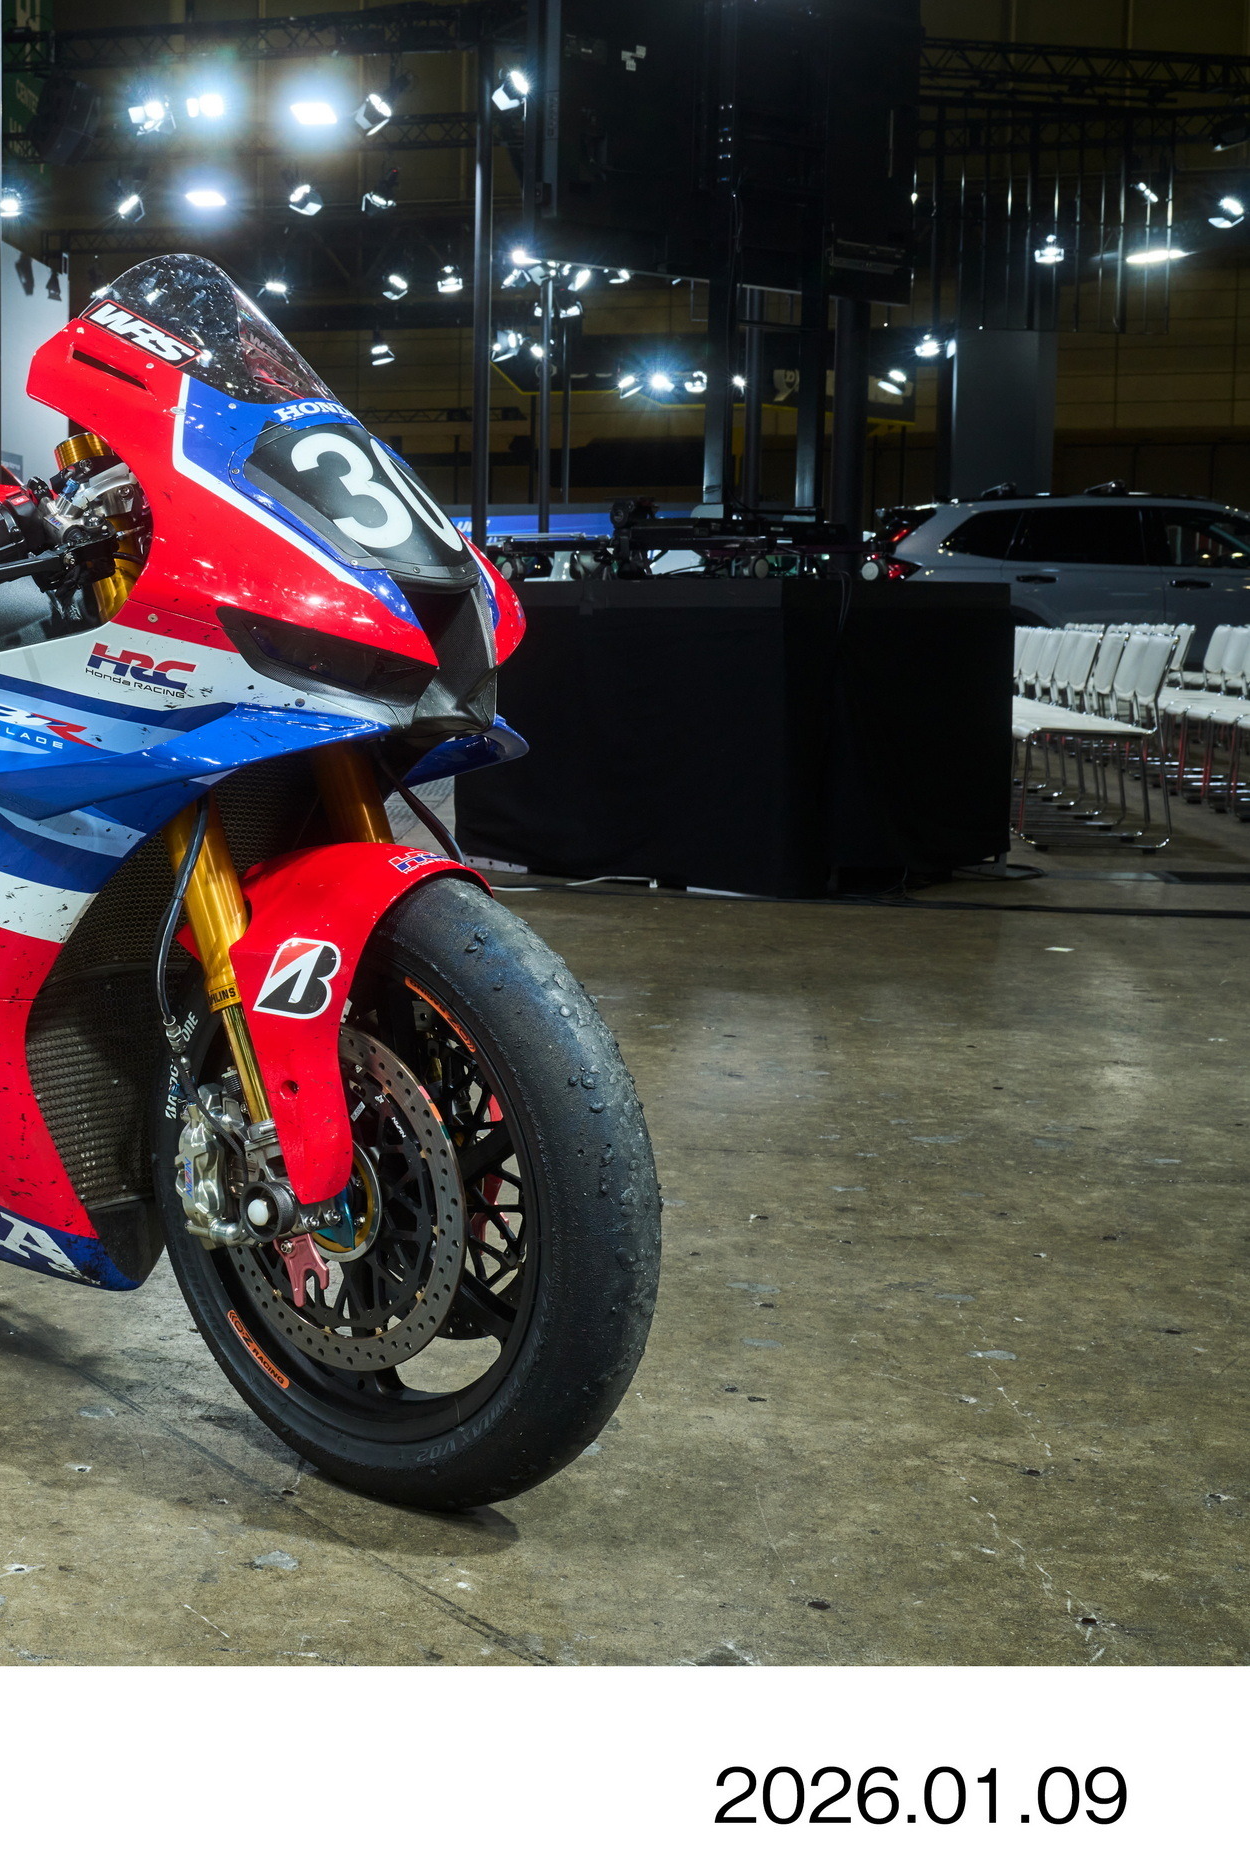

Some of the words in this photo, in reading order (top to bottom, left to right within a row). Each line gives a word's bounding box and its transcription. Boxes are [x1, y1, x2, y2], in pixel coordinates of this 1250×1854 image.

[89, 303, 196, 361] WRS
[274, 402, 356, 421] HOND
[291, 433, 463, 552] 30
[85, 668, 131, 686] Honda
[133, 681, 185, 699] RACING
[87, 643, 196, 691] HRC
[209, 987, 236, 1006] HLINS
[252, 1348, 284, 1385] RACING
